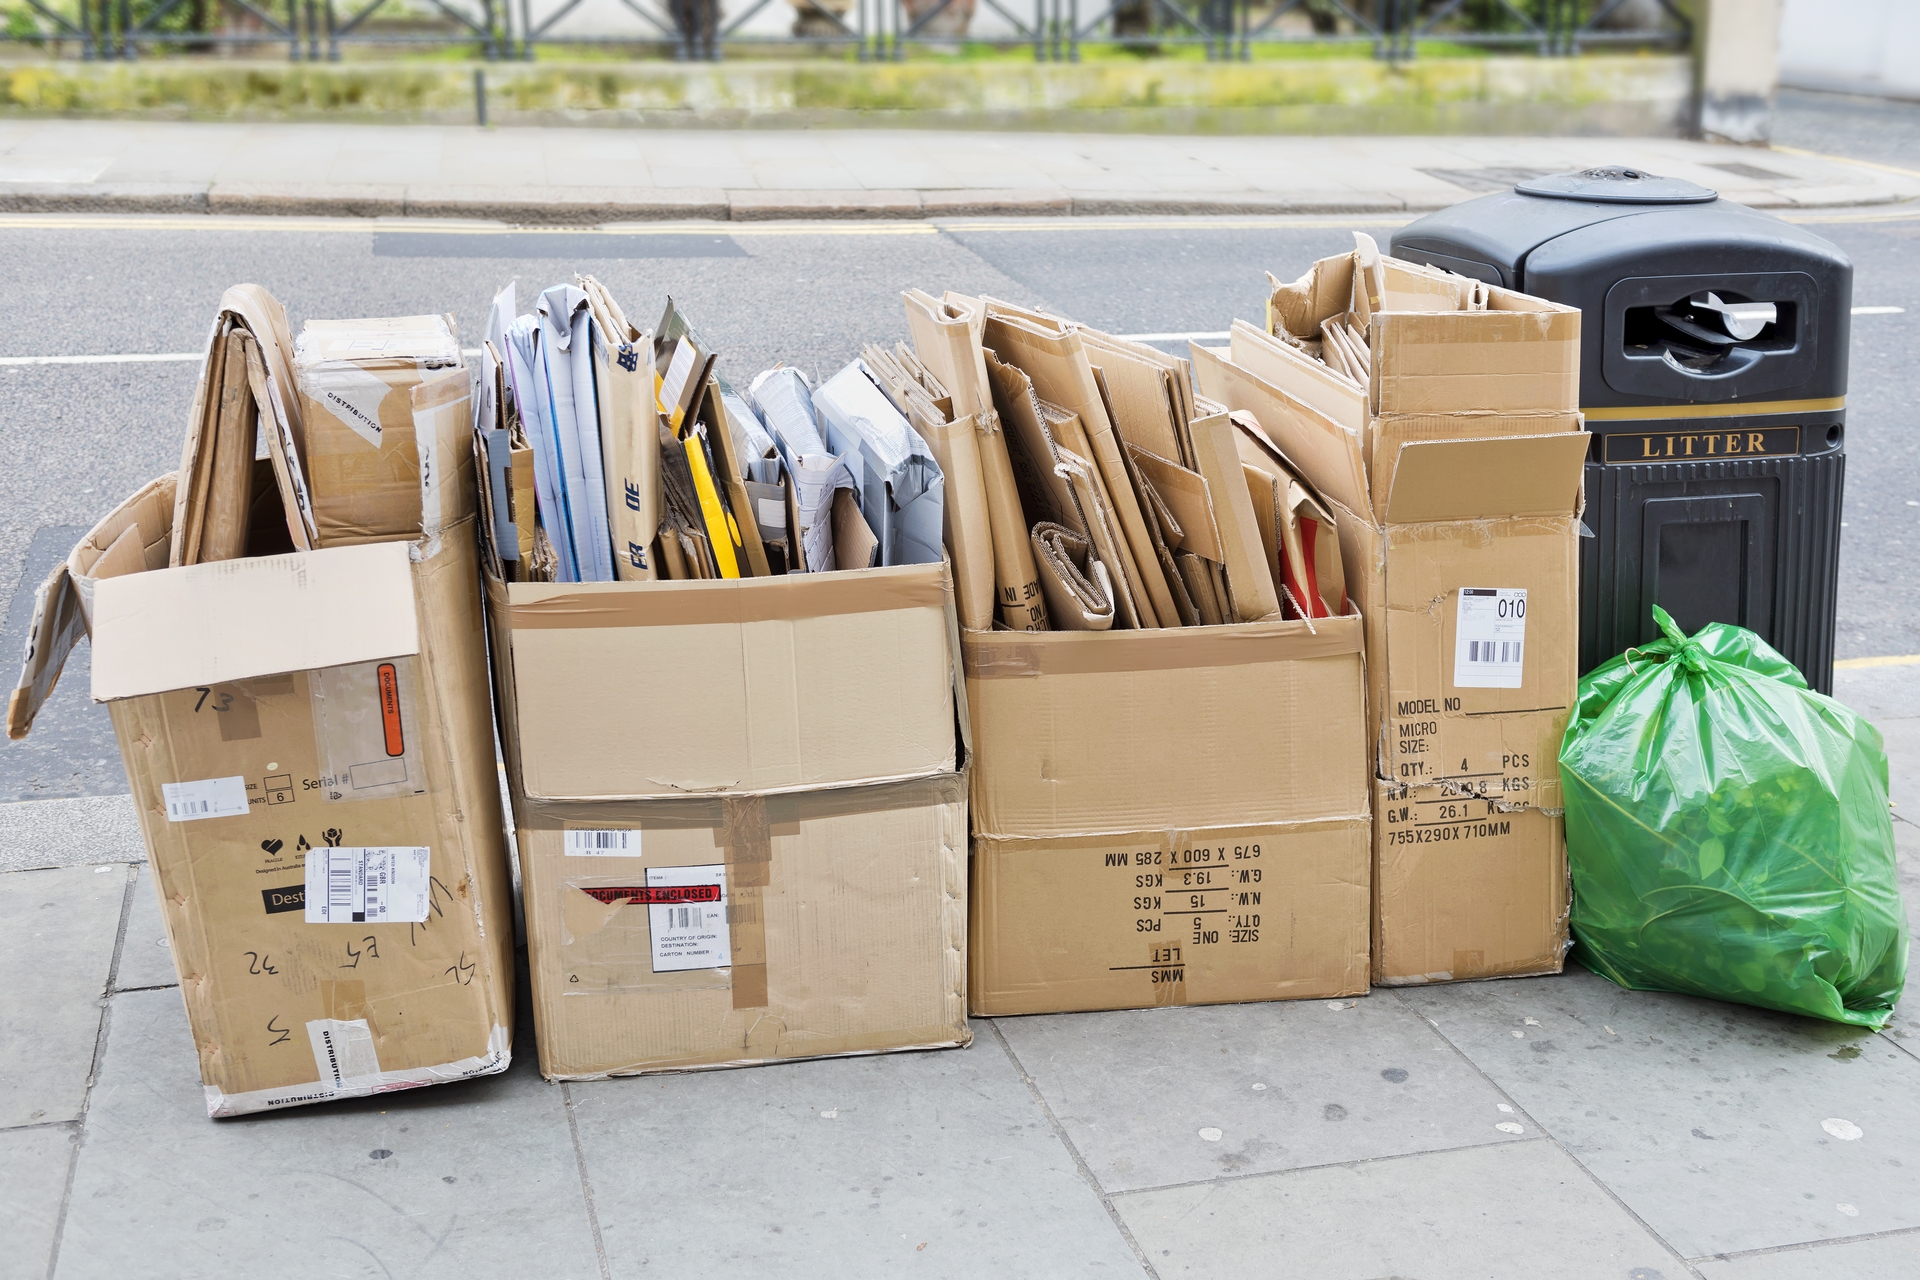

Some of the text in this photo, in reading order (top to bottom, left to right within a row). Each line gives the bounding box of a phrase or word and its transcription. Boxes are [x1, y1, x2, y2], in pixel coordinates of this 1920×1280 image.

[327, 392, 383, 433] DISTRIBUTION
[1642, 432, 1766, 457] LITTER
[1004, 581, 1040, 602] ADE IN
[1498, 598, 1526, 619] 010
[195, 687, 235, 713] 73
[383, 671, 395, 715] DOCUMENTS
[1397, 697, 1461, 716] MODEL NO
[1399, 721, 1437, 738] MICRO
[1399, 738, 1430, 754] SIZE:
[1401, 753, 1530, 777] QTY.: 4 PCS
[302, 774, 339, 791] Serial
[1502, 776, 1530, 792] KGS
[276, 792, 285, 802] 6
[1387, 806, 1418, 824] G.W.:
[1439, 804, 1468, 819] 26.1
[1105, 844, 1261, 867] 675 X 600 X 285 MM
[379, 871, 387, 885] GBR
[1135, 868, 1262, 888] G.W.: 19.3 KGS
[655, 887, 712, 901] ENCLOSED
[1133, 892, 1261, 910] N.W.: 15 KGS
[1136, 914, 1261, 933] QTY.: 5 PCS
[1192, 929, 1260, 945] SIZE: ONE
[1152, 947, 1181, 963] LET
[1151, 968, 1183, 984] MMS
[322, 1030, 343, 1089] DISTRIBUTION
